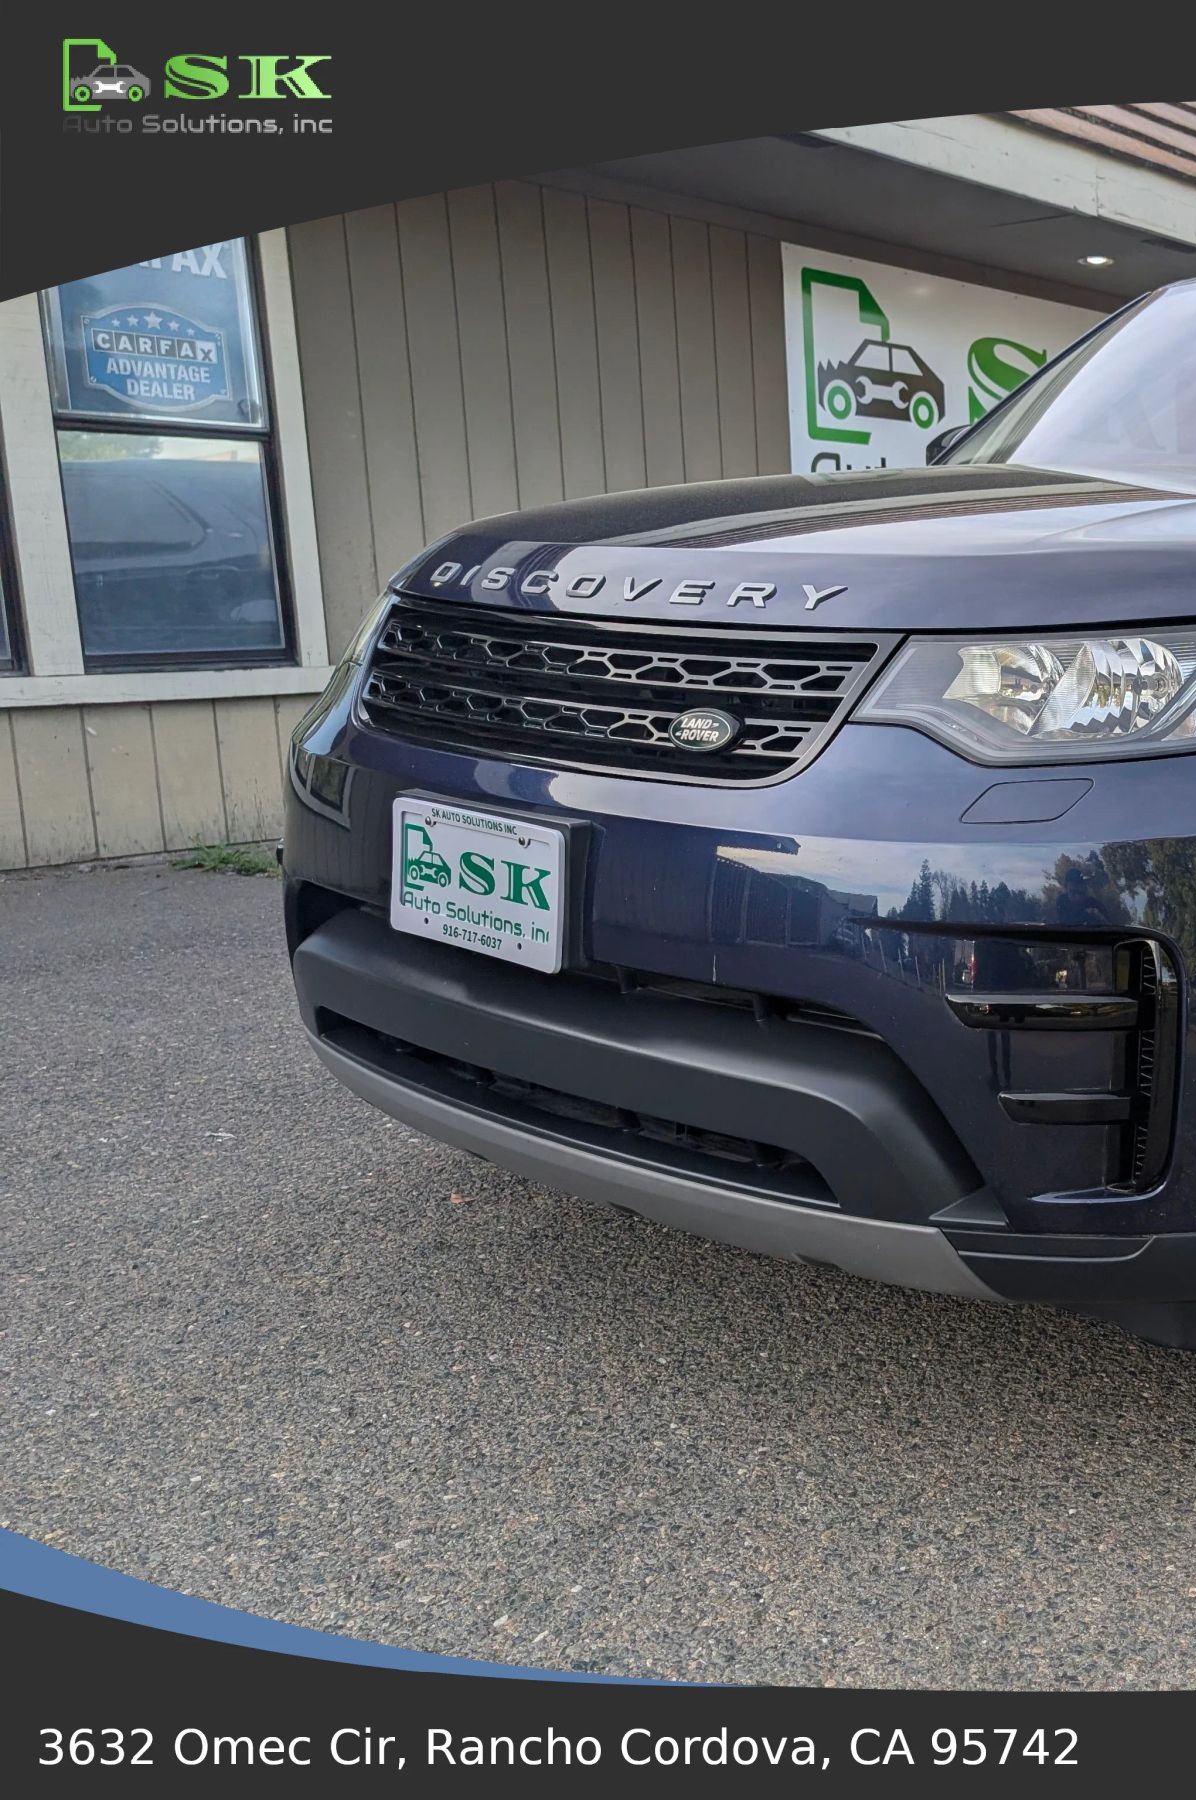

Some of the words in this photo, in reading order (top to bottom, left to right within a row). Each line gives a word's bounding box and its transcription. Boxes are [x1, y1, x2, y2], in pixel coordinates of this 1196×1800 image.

[95, 330, 217, 363] CARFAX
[106, 358, 211, 384] ADVANTAGE
[126, 378, 196, 401] DEALER
[429, 560, 848, 611] DISCOVERY
[680, 717, 713, 730] LAND
[680, 729, 720, 742] ROVER
[431, 808, 441, 818] SK
[442, 810, 461, 823] AUTO
[462, 814, 503, 832] SOLUTIONS
[504, 823, 518, 836] INC
[458, 851, 551, 912] SK
[403, 890, 442, 915] Auto
[445, 901, 526, 939] Solutions,
[442, 923, 503, 951] 916-717-6037
